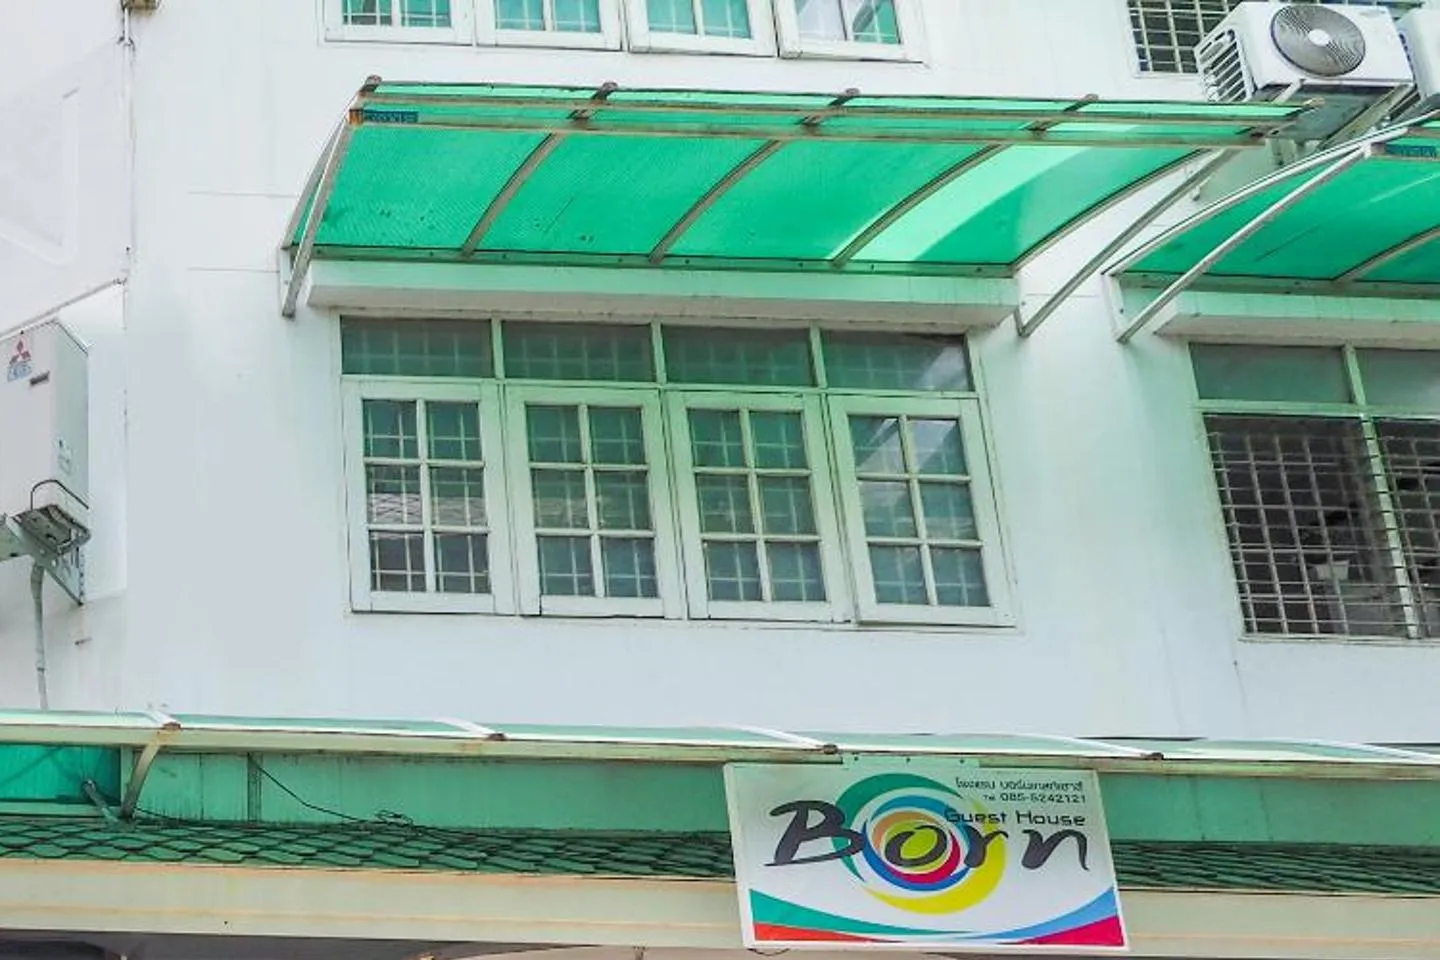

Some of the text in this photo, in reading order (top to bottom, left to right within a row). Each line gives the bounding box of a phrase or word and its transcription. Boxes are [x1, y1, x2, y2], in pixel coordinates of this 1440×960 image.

[764, 799, 1090, 872] Born
[944, 808, 1086, 827] Guest House
